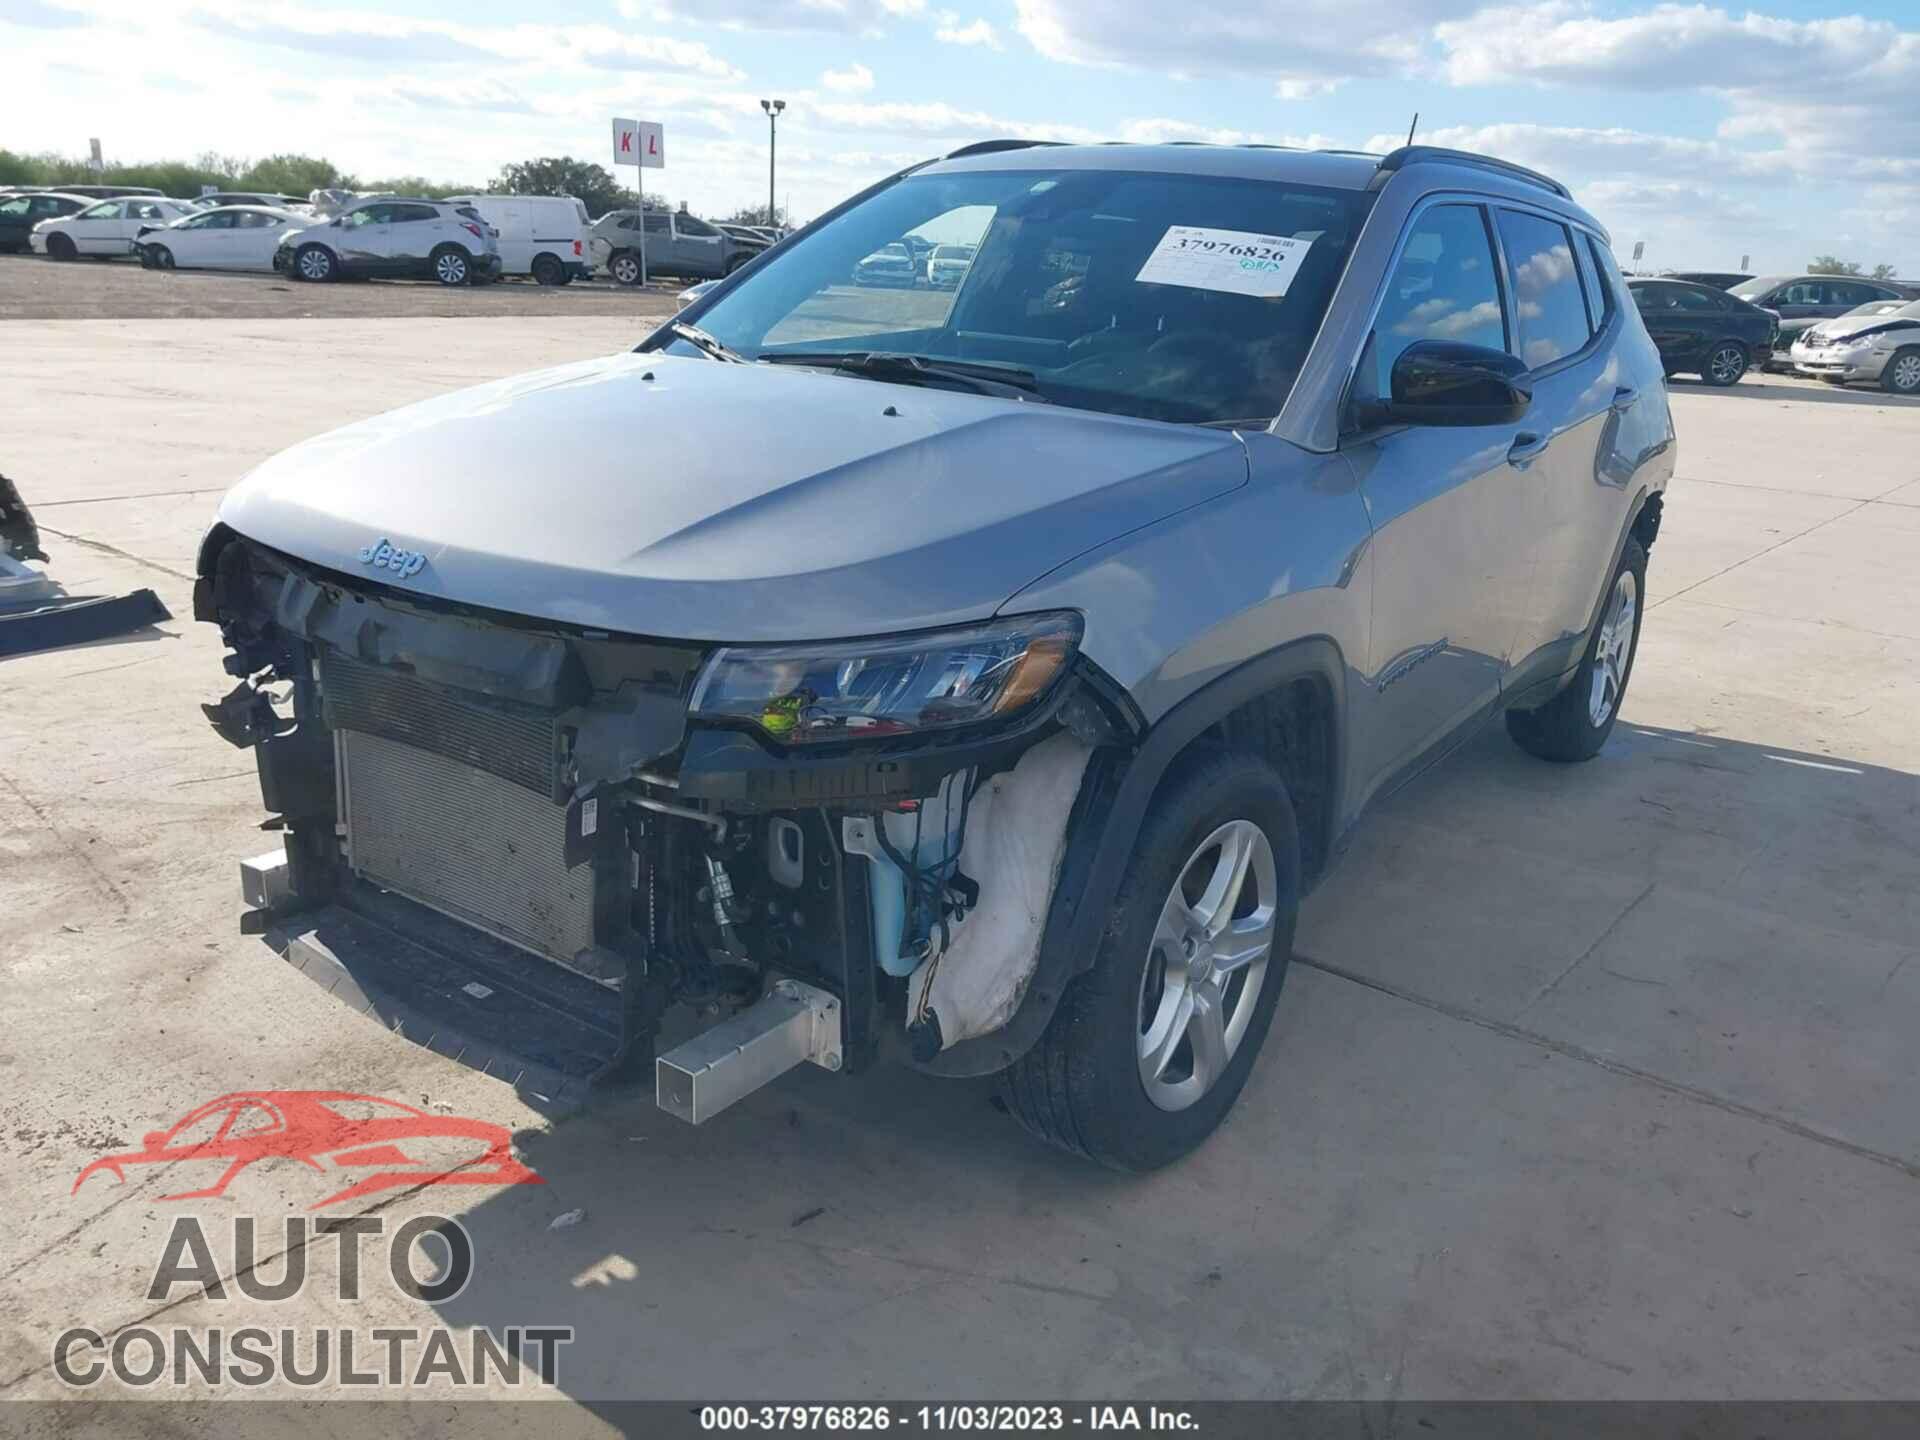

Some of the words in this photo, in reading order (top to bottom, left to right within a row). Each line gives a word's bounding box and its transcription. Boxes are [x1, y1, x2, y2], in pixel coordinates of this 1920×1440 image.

[621, 131, 632, 152] K
[648, 135, 657, 155] L
[1172, 238, 1286, 262] 37976826
[360, 537, 426, 578] Jeep
